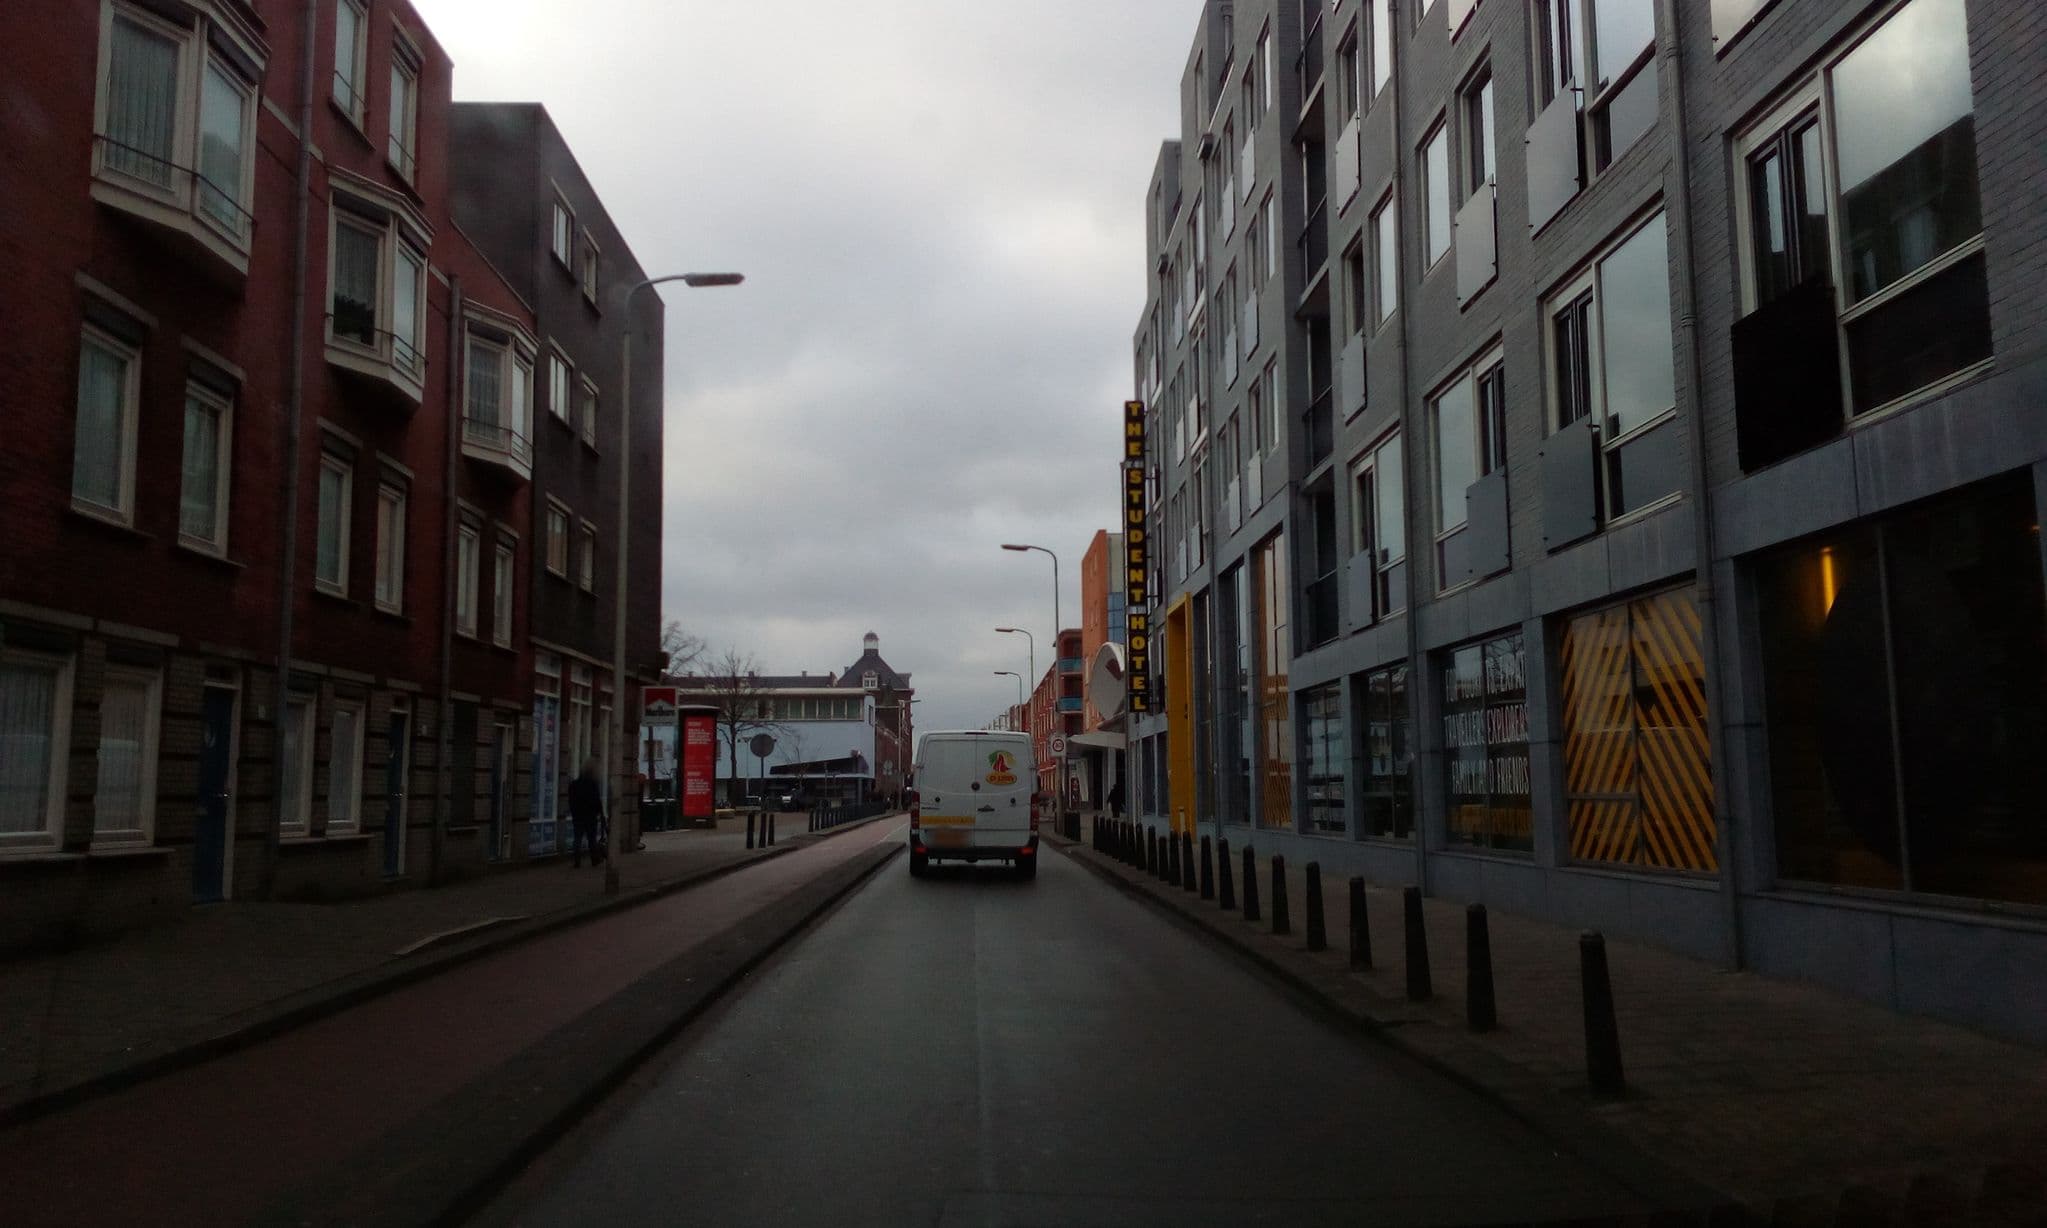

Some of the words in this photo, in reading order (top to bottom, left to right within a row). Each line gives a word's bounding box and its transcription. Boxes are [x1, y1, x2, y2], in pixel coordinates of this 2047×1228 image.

[1127, 402, 1142, 456] THE
[1128, 470, 1144, 603] STUDENT
[1130, 616, 1146, 710] HOTEL
[1487, 704, 1529, 744] EXPLORERS
[1452, 759, 1476, 794] FAMILY
[1496, 756, 1530, 794] FRIENDS
